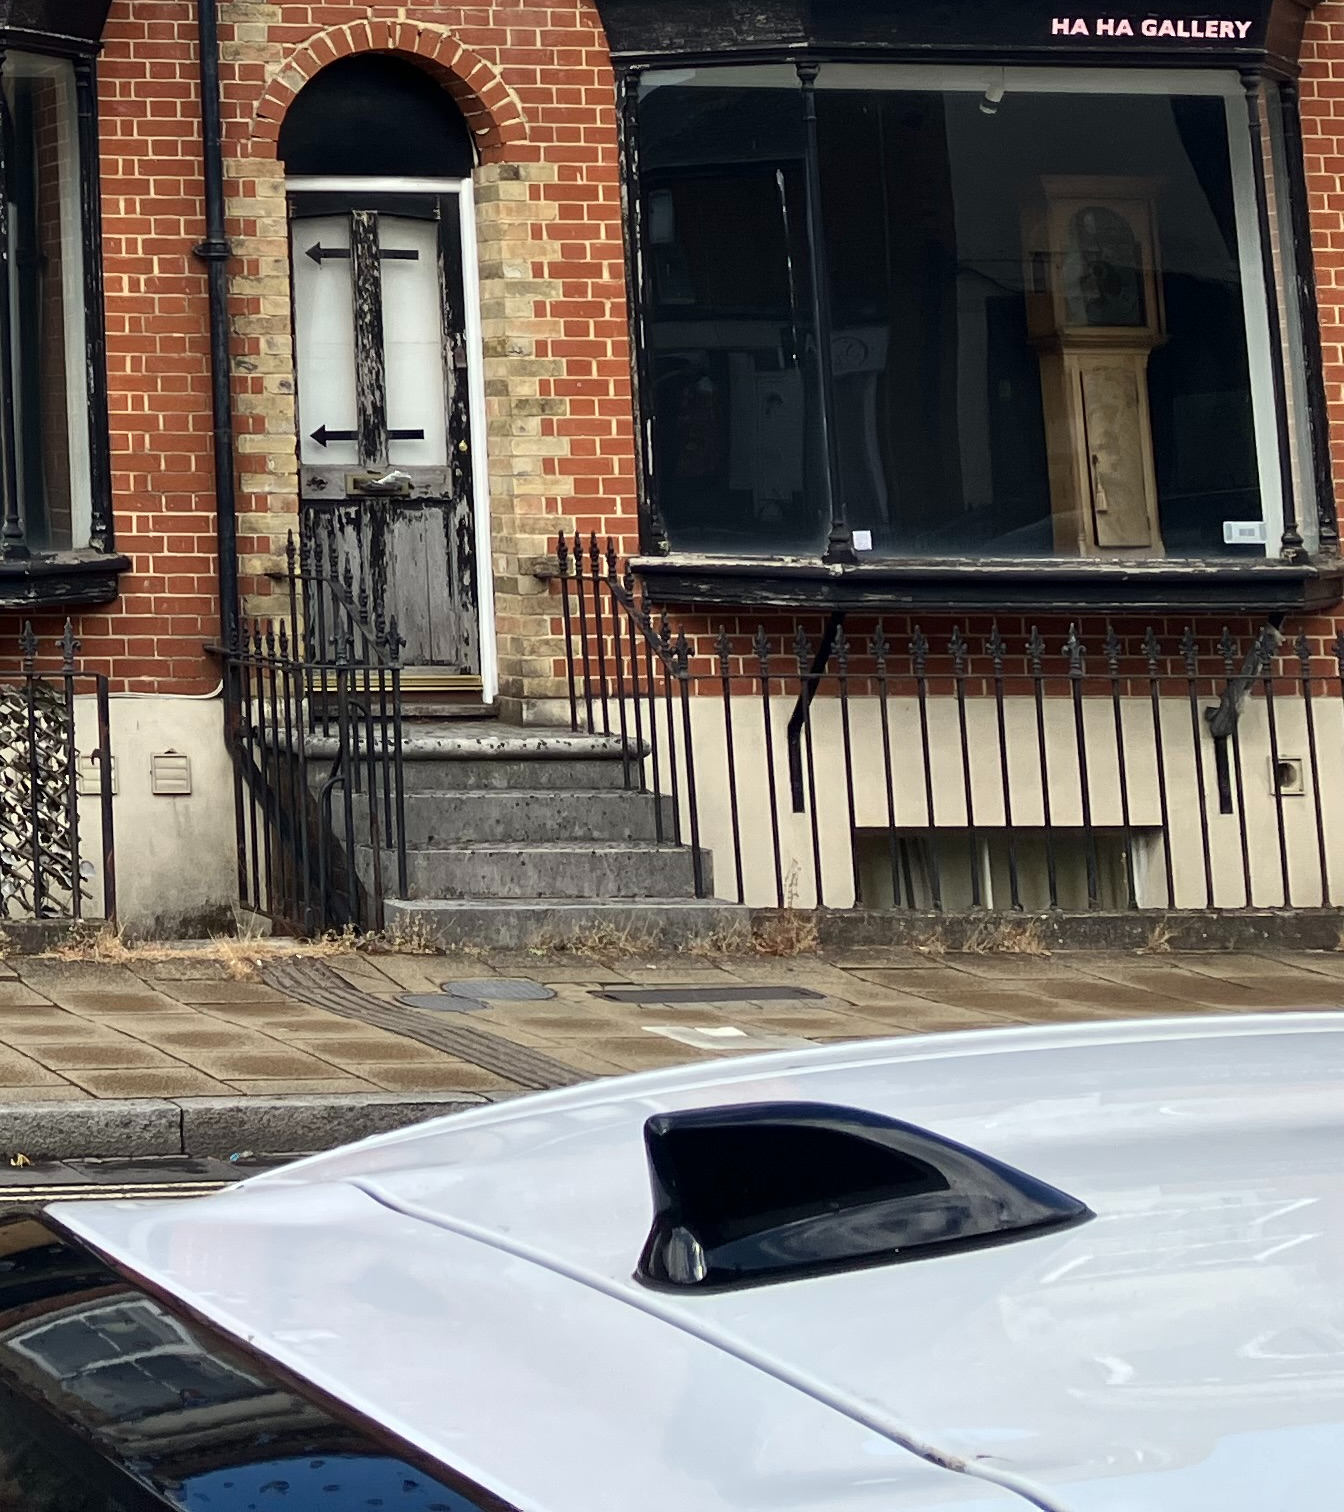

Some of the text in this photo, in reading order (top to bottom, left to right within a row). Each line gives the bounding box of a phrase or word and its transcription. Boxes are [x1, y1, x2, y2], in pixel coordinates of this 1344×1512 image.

[1051, 17, 1253, 39] HA HA GALLERY
